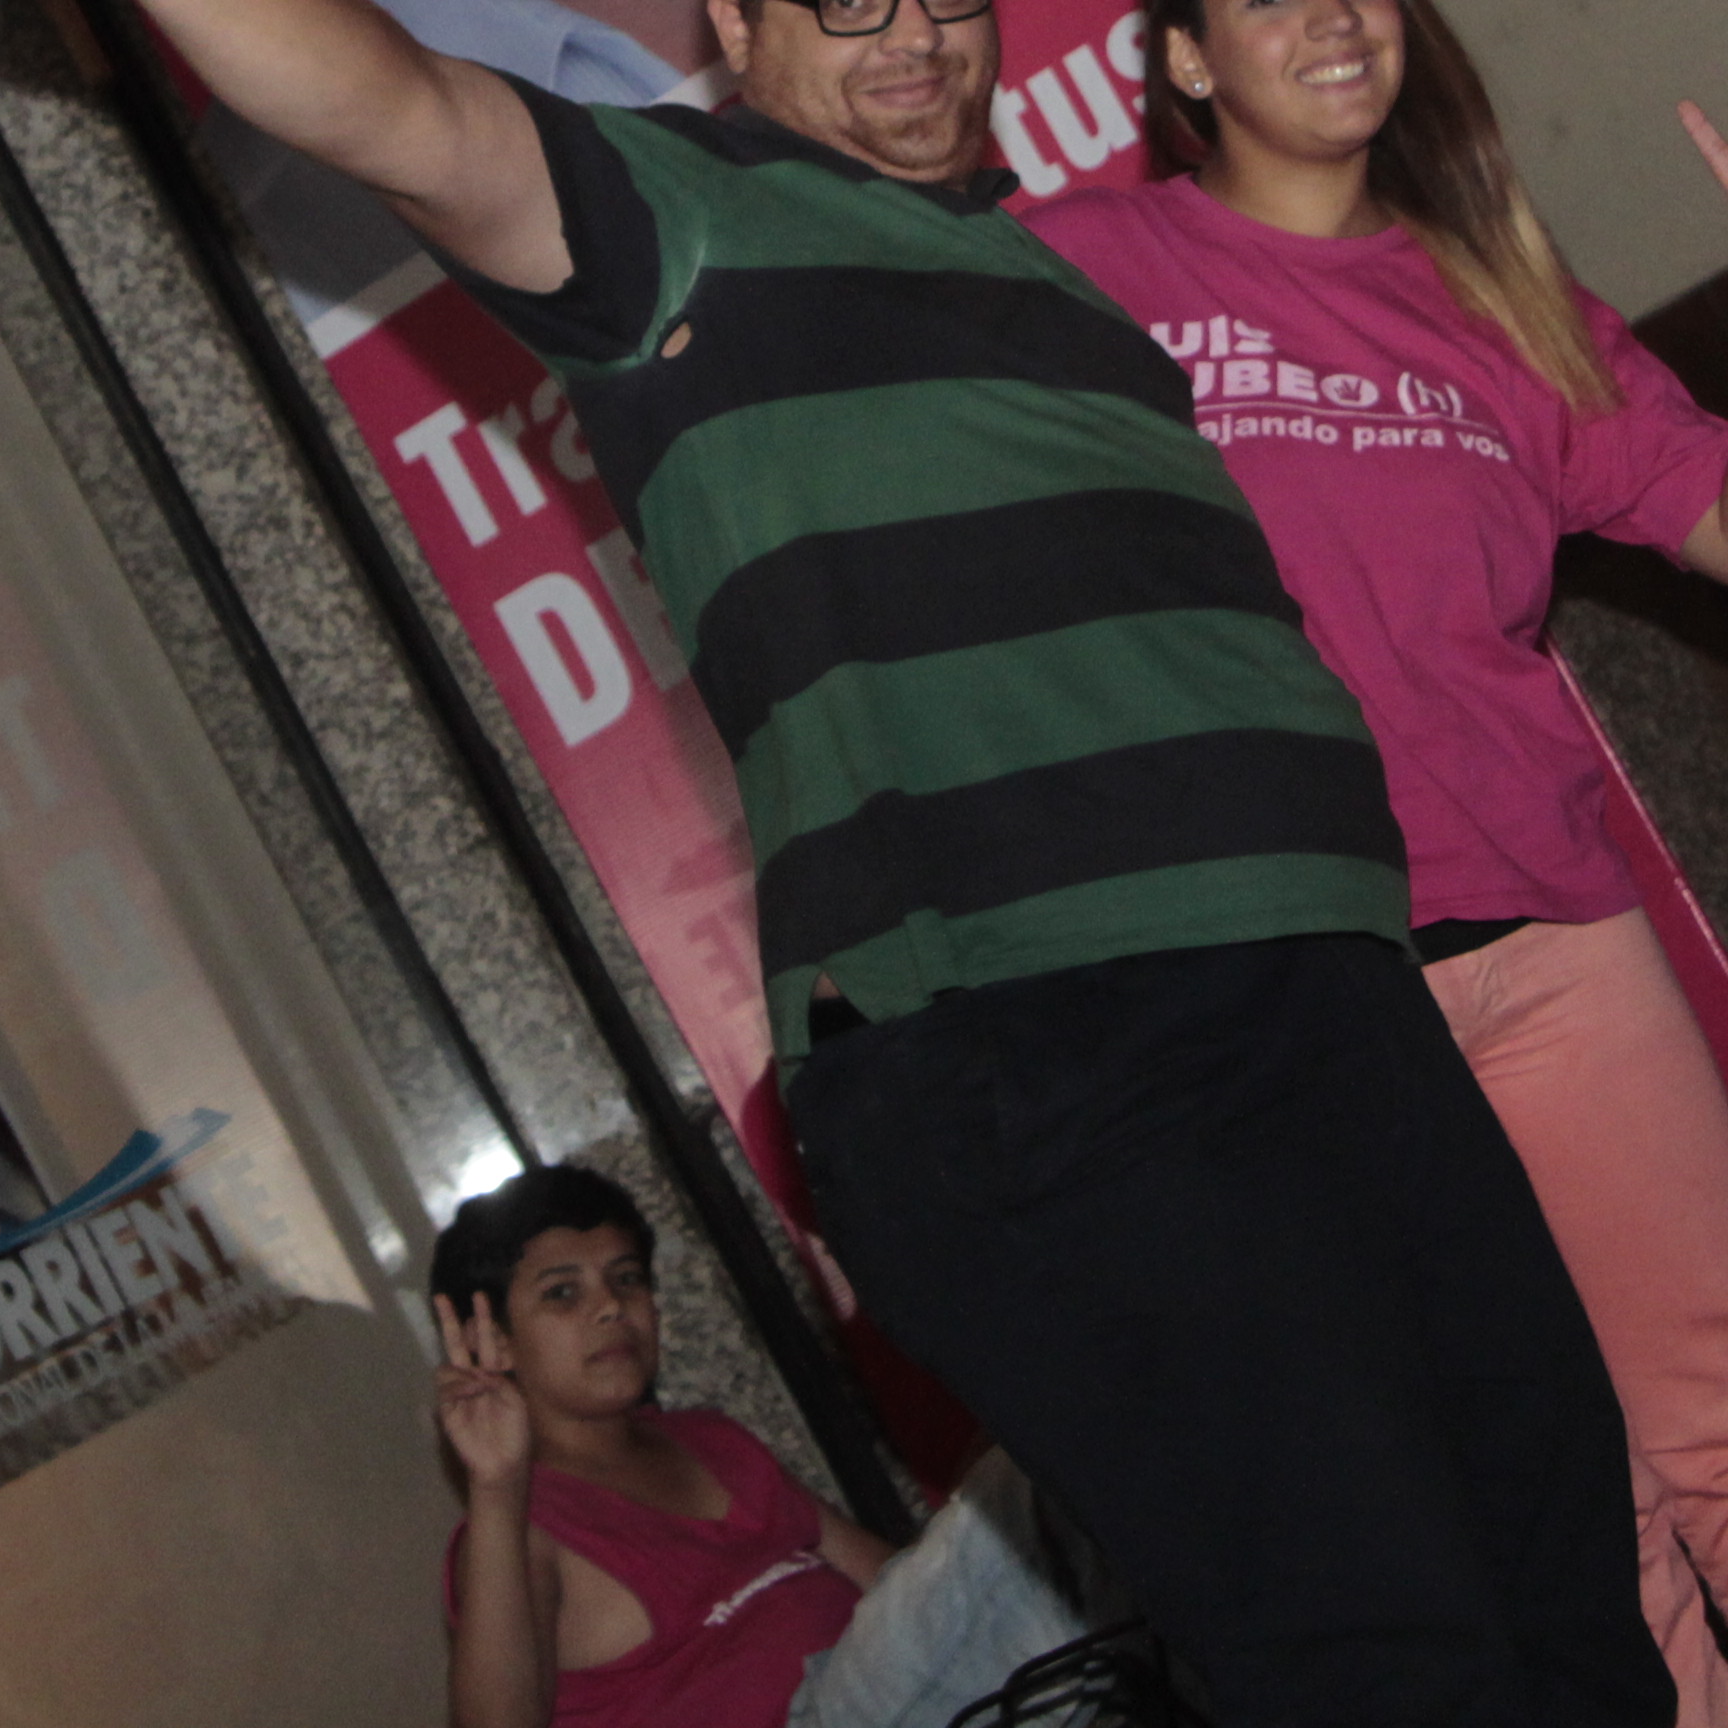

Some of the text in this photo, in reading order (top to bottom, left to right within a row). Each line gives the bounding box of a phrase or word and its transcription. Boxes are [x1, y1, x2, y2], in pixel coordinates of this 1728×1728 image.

[1397, 370, 1464, 419] (h)
[1352, 425, 1446, 454] para
[1456, 430, 1511, 463] vos
